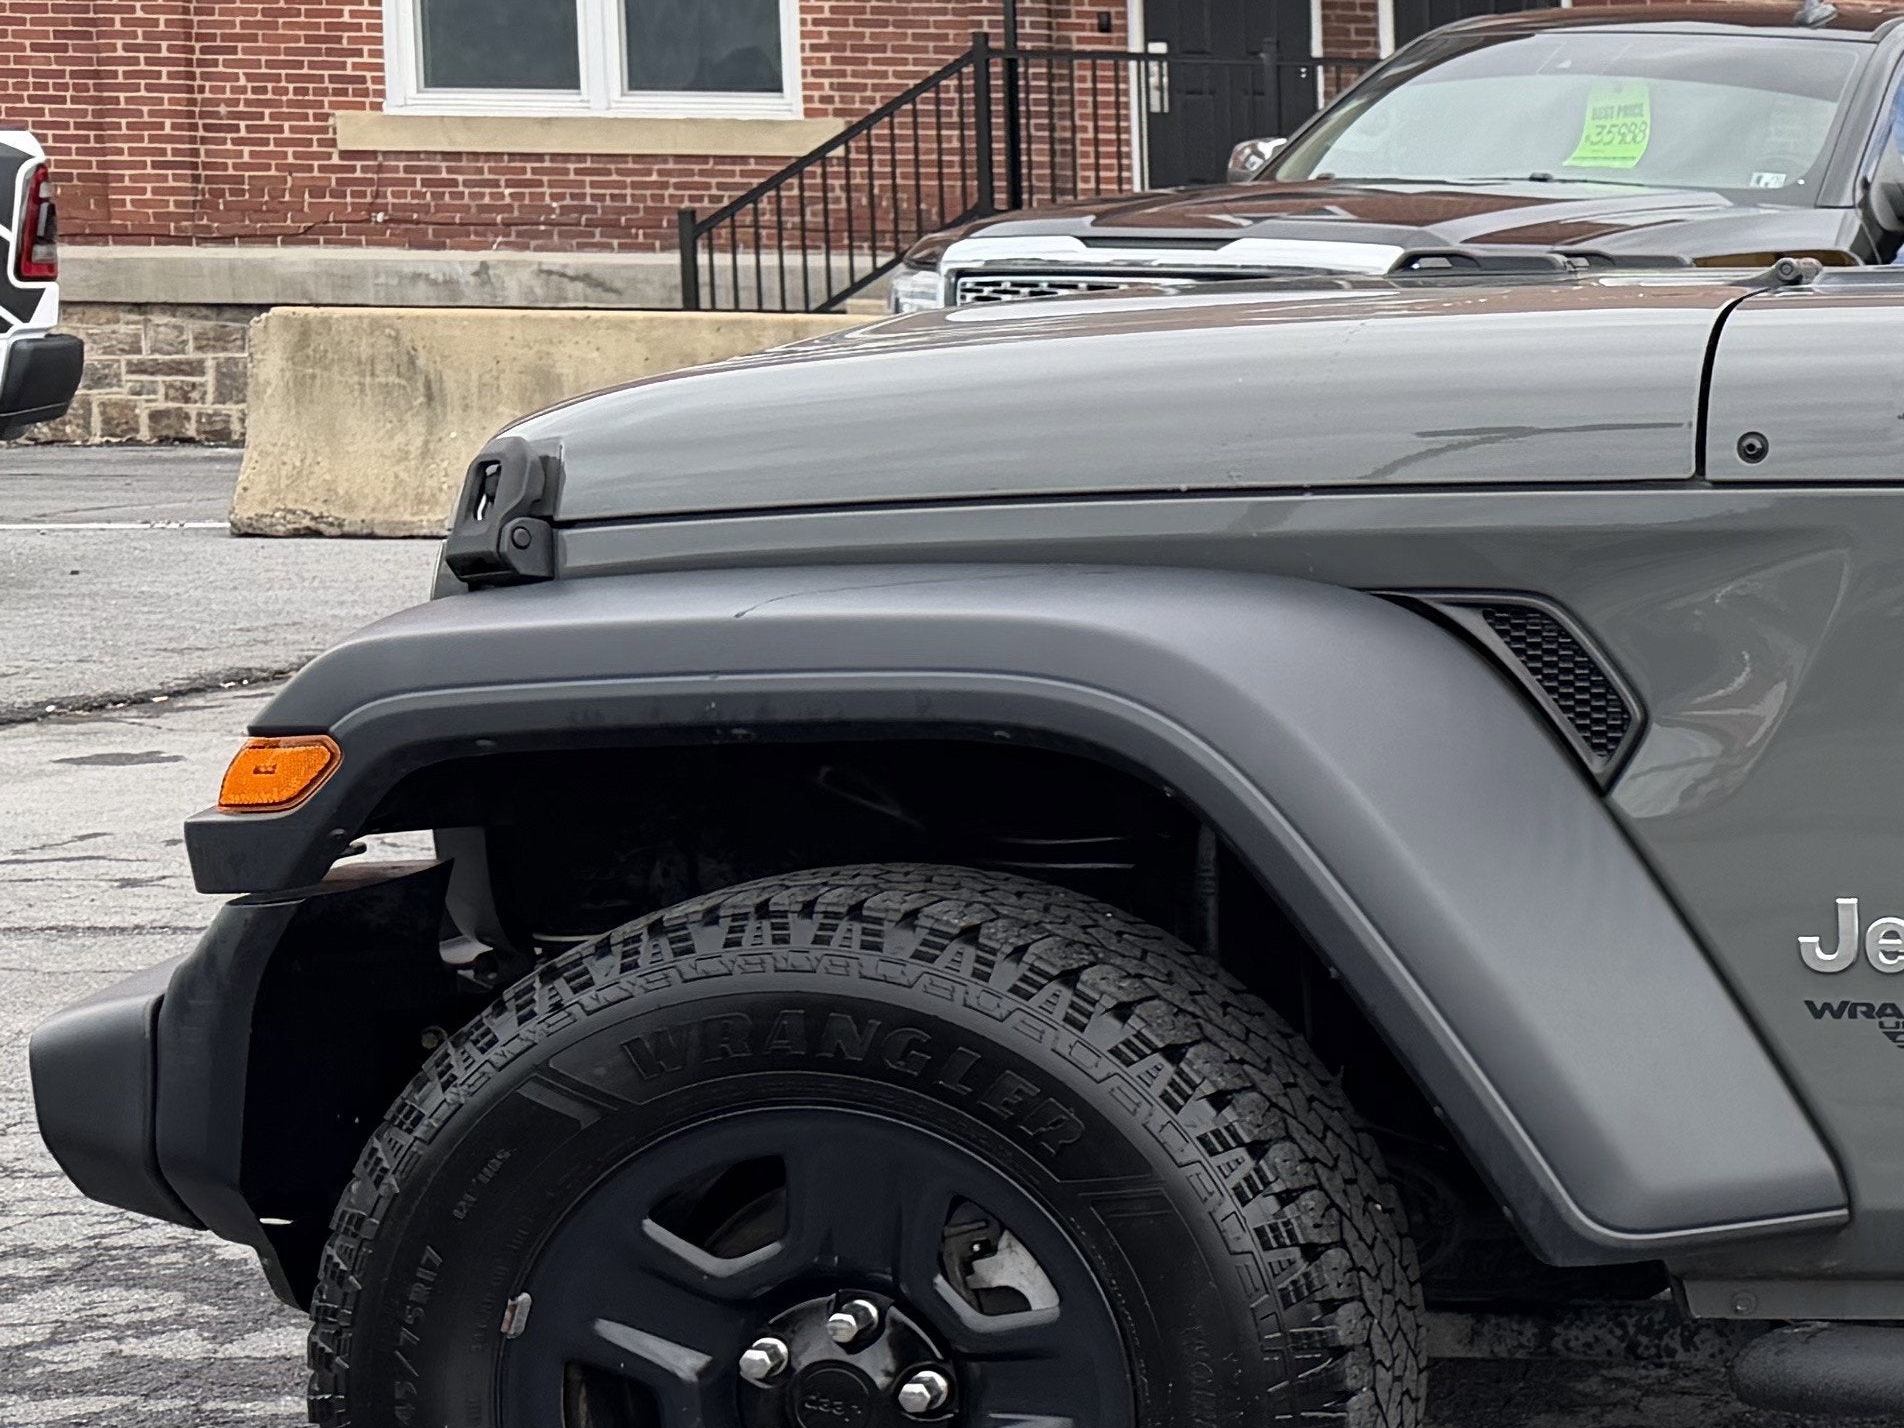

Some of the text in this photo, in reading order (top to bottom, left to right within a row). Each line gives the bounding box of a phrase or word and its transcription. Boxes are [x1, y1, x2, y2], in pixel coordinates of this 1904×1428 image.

[1592, 102, 1644, 121] BEST PRICE
[619, 1008, 1086, 1158] WRANGLER
